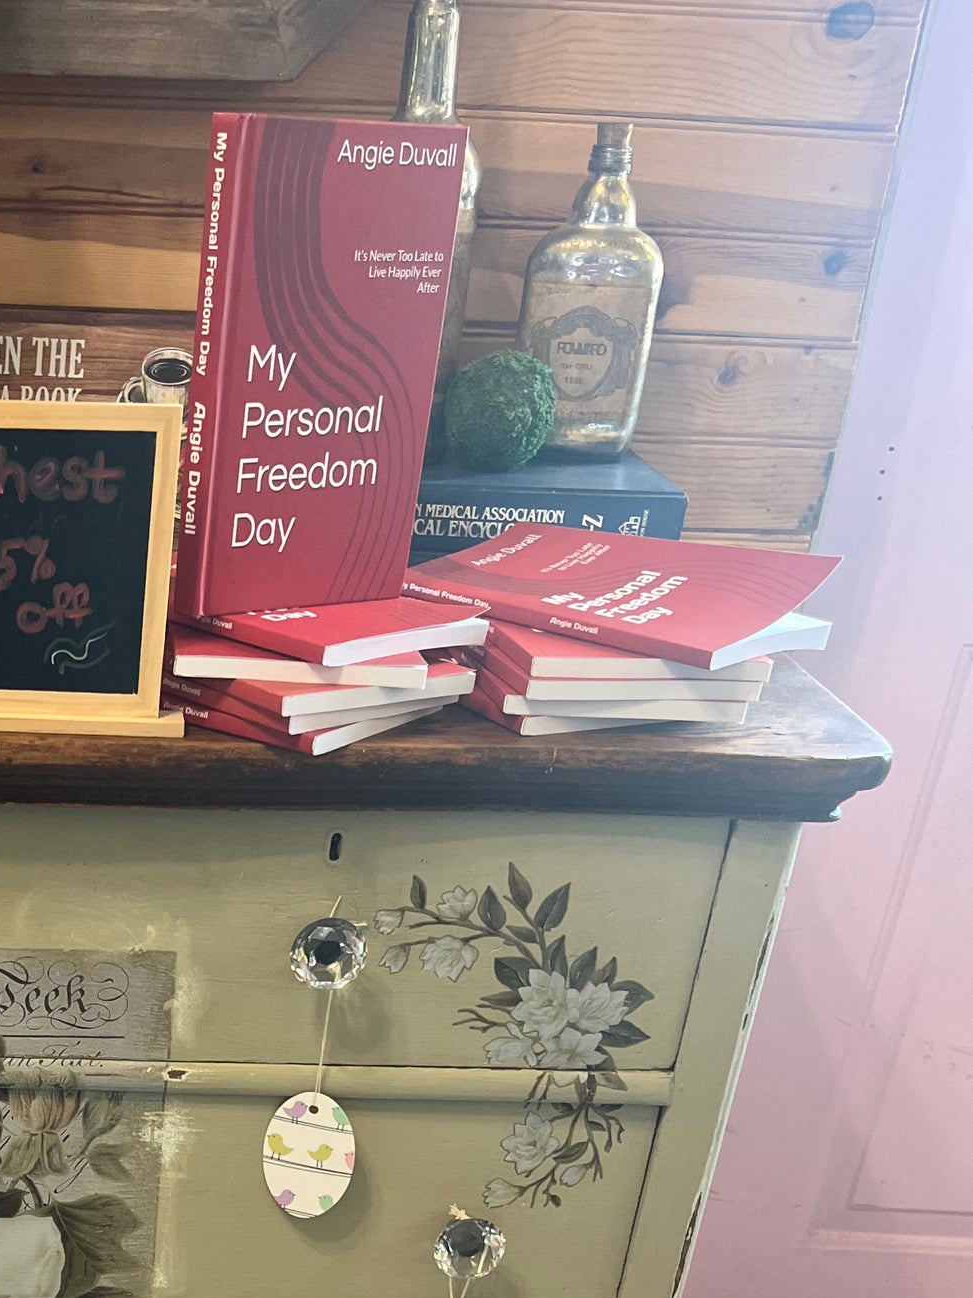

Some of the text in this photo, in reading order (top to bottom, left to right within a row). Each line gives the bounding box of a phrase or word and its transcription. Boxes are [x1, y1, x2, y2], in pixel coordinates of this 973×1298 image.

[337, 138, 458, 171] Angie Duvall
[195, 131, 227, 377] My Personal Freedom Day
[354, 249, 444, 262] It's Never Too Late to
[368, 265, 442, 280] Live Happily Ever
[416, 281, 440, 293] After
[32, 336, 86, 379] THE
[247, 344, 296, 391] My
[241, 395, 384, 439] Personal
[183, 401, 207, 535] Angie Duvall
[237, 451, 377, 494] Freedom
[425, 504, 480, 520] MEDICAL
[482, 506, 565, 524] ASSOCIATION
[230, 512, 296, 553] Day
[470, 534, 543, 567] Angie Duvall
[409, 582, 441, 597] Personal
[441, 590, 473, 605] Freedom
[474, 598, 489, 609] Day
[541, 591, 585, 606] My
[567, 570, 662, 612] Personal
[594, 575, 689, 618] Freedom
[15, 582, 93, 634] off
[212, 617, 233, 630] Duvall
[261, 607, 317, 622] Day
[621, 606, 674, 625] Day
[549, 616, 599, 635] Angie Duvall
[185, 706, 209, 719] Duvall
